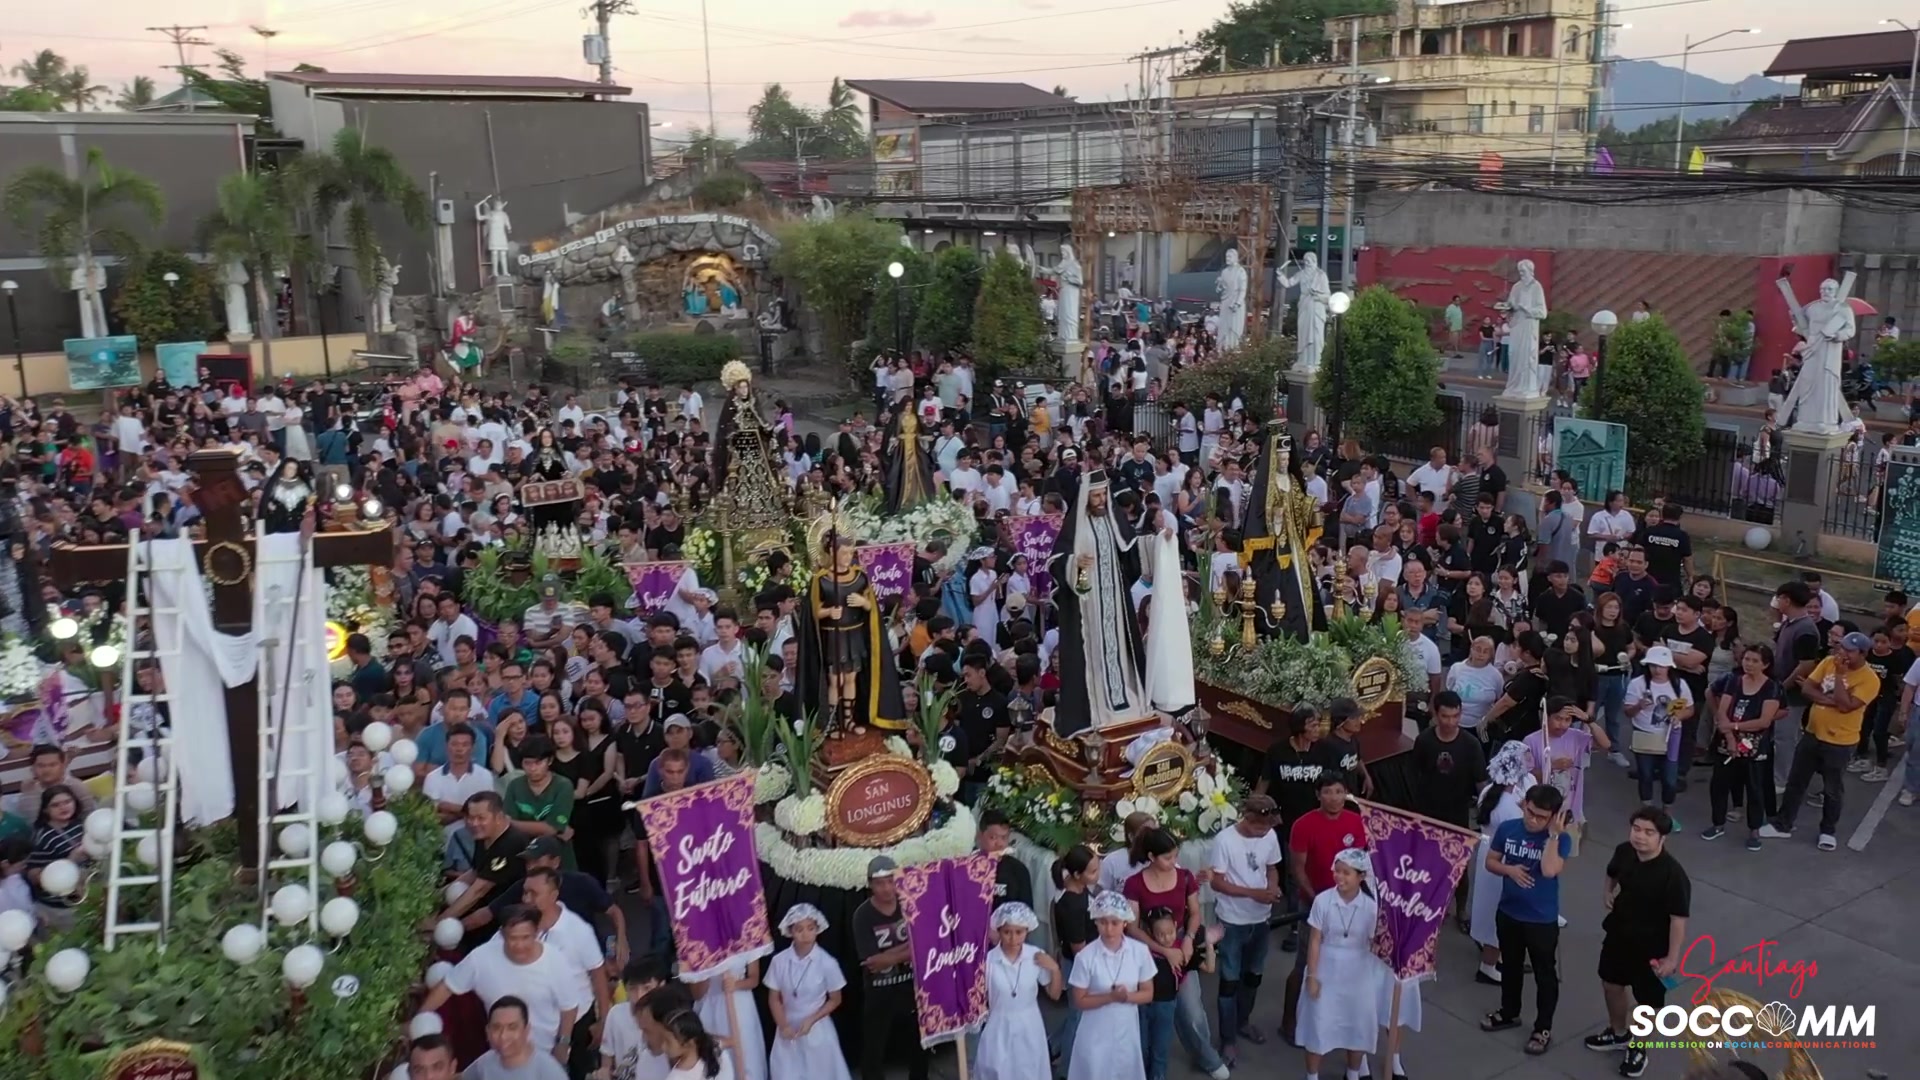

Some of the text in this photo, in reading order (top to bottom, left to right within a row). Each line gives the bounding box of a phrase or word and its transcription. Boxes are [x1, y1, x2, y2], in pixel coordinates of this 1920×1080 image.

[1023, 530, 1053, 547] Santa
[871, 563, 903, 582] Santa
[941, 738, 954, 749] 16
[1156, 760, 1171, 773] SAN
[1144, 767, 1182, 787] NICODEMO
[864, 782, 890, 801] SAN
[847, 794, 912, 824] LONGINUS
[676, 822, 736, 876] Santo
[1393, 854, 1432, 884] San
[674, 867, 753, 920] Entierro
